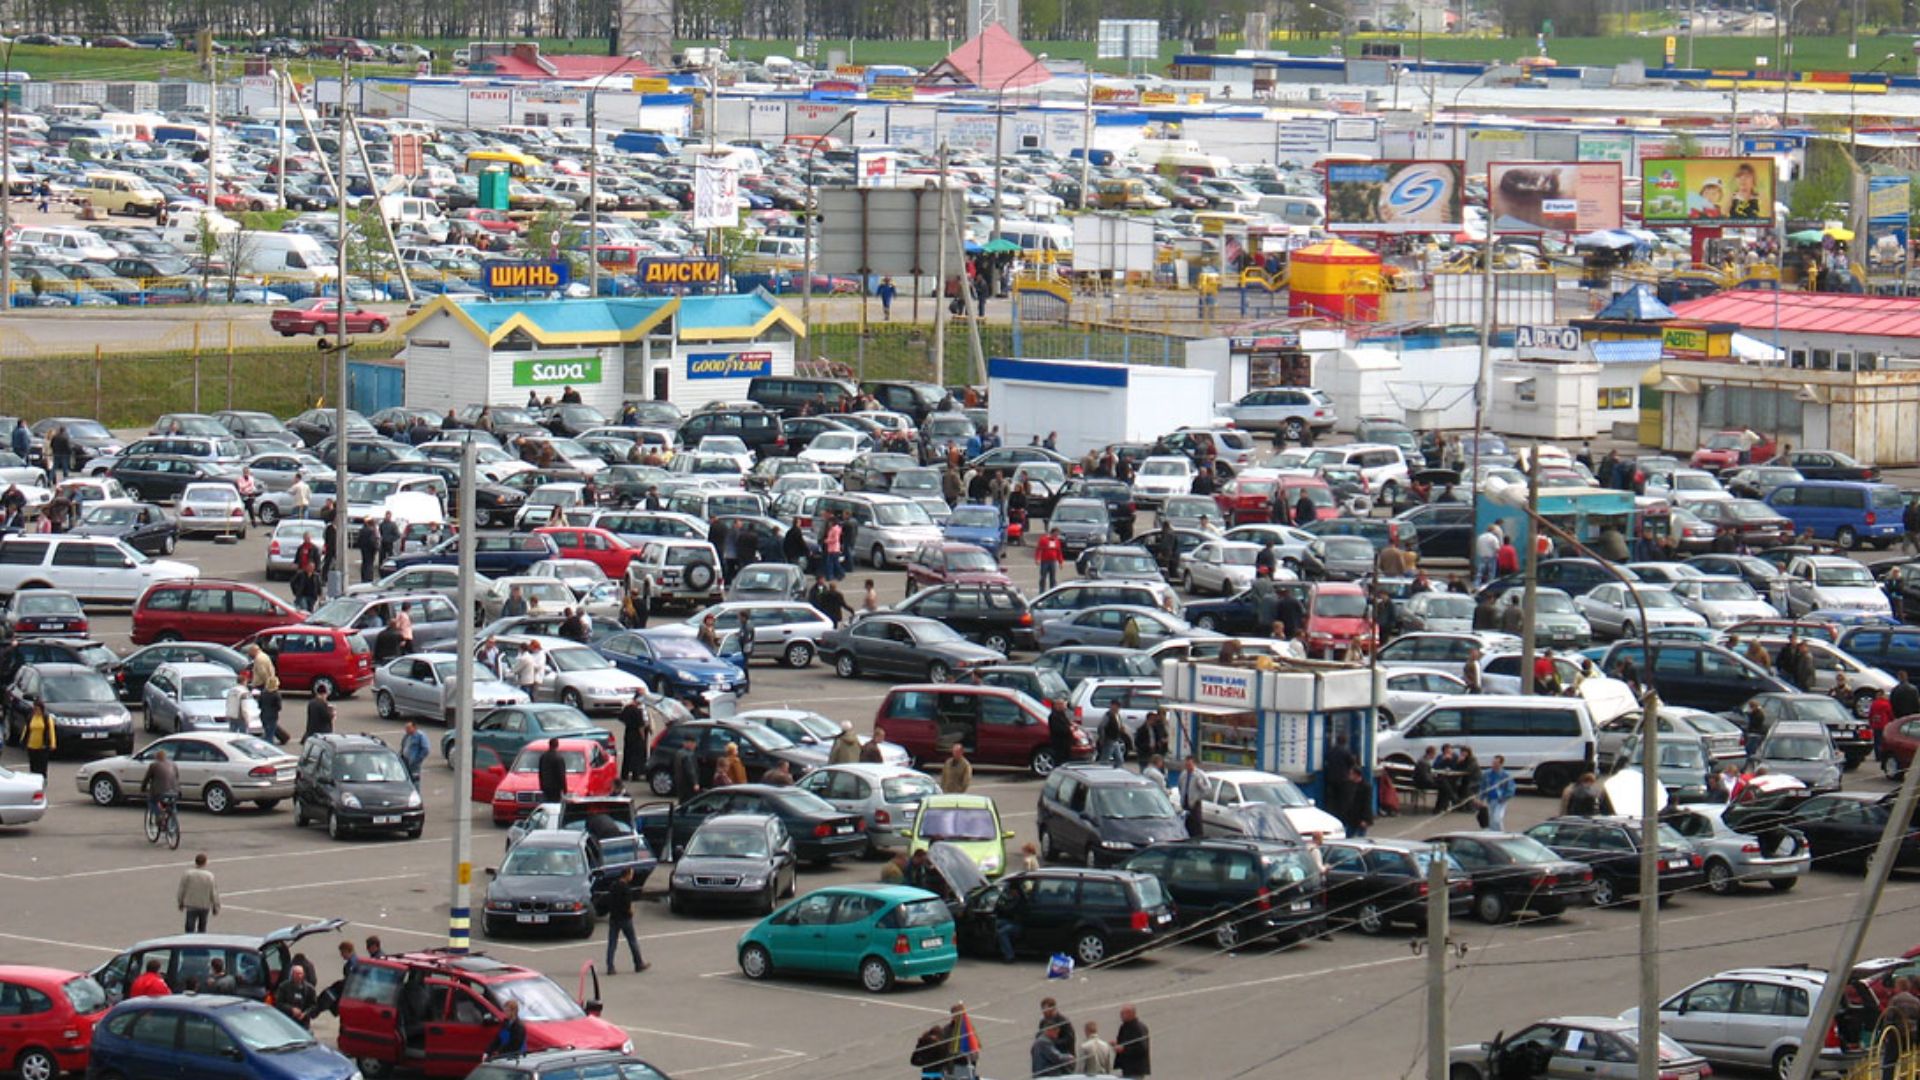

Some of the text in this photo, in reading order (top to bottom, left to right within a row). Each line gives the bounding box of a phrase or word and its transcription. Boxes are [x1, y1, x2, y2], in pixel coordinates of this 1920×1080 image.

[646, 262, 720, 283] ДИСКИ
[1517, 327, 1577, 350] АВТО
[1202, 684, 1246, 699] ТАТЬЯНА
